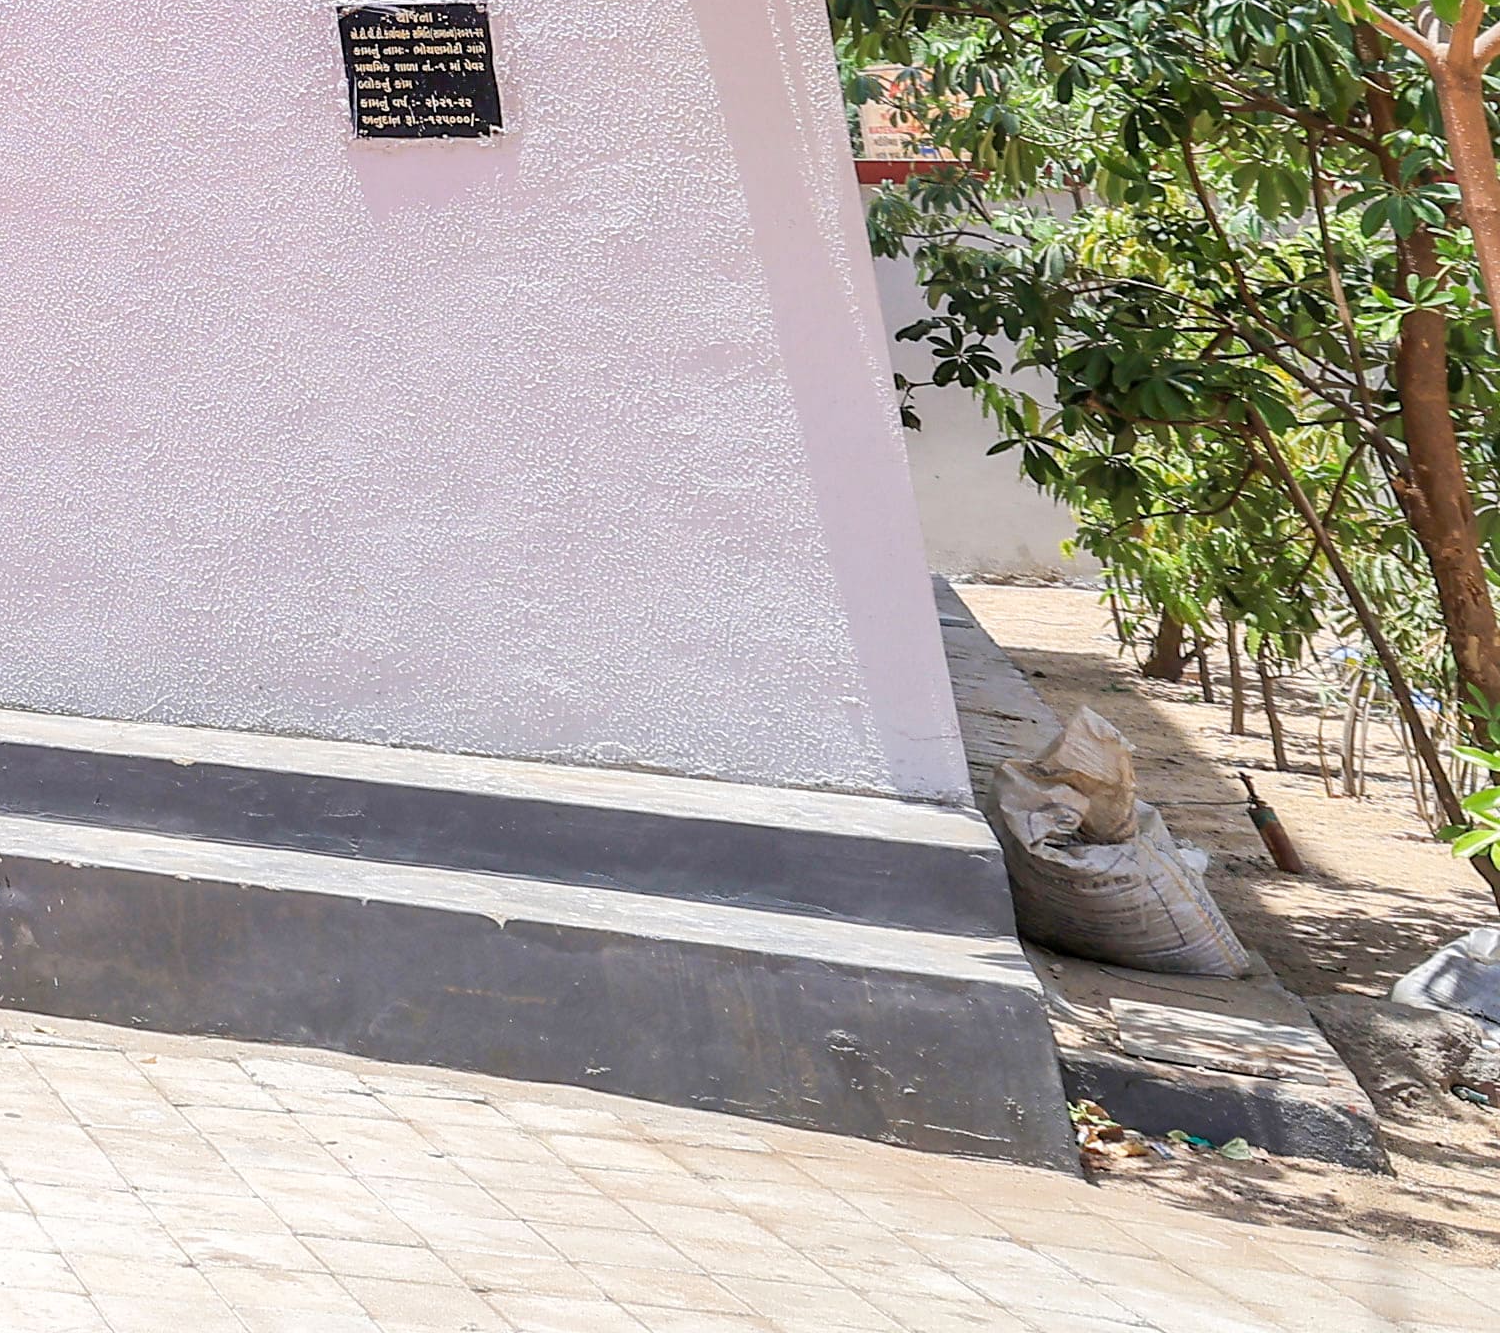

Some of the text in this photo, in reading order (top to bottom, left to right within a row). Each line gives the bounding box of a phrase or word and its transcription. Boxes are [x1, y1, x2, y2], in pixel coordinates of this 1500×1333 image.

[353, 43, 381, 59] કામનું
[413, 42, 463, 56] ભોયણમોટી
[354, 60, 391, 73] પ્રાથમિક
[394, 62, 419, 72] શાળા
[360, 95, 390, 112] કામનું
[361, 115, 401, 129] અનુદાન
